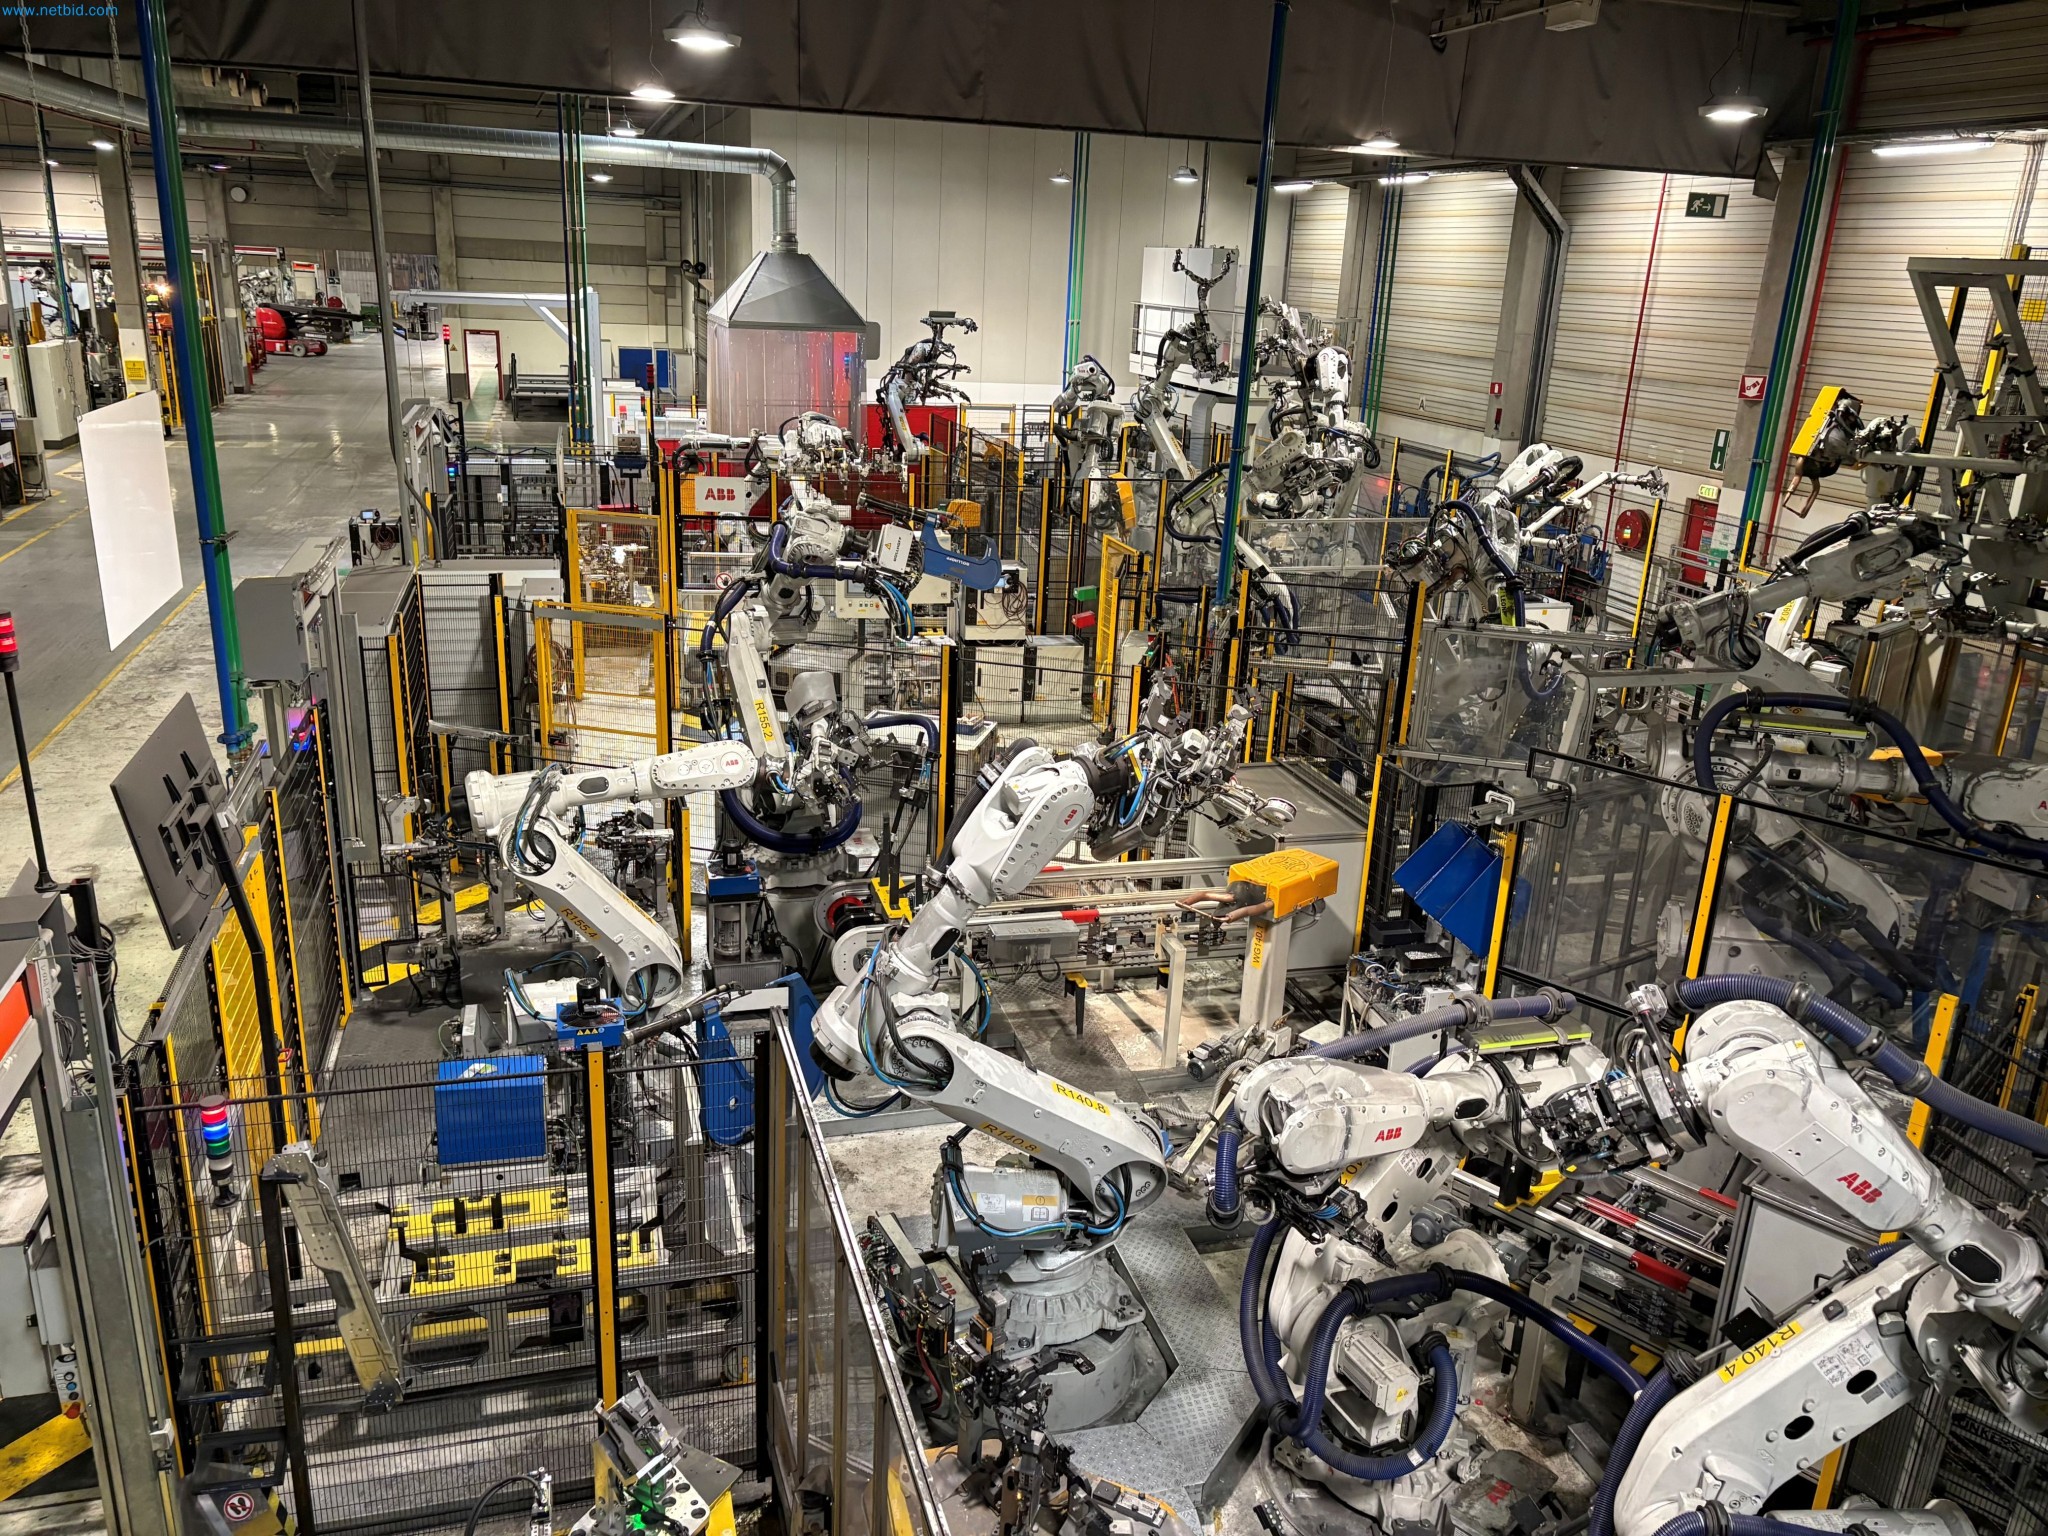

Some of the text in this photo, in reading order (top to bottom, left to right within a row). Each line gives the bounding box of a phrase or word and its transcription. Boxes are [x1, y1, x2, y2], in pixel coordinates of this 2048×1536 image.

[705, 487, 736, 502] ABB
[754, 701, 775, 739] R155.2
[725, 759, 740, 768] ABB
[1064, 809, 1077, 825] ABB
[560, 907, 598, 939] R155.4
[1251, 924, 1265, 964] WG140.1
[1055, 1083, 1107, 1115] R140.8
[982, 1122, 1038, 1152] R140.8
[1374, 1126, 1402, 1143] ABB
[1835, 1172, 1883, 1204] ABB
[1723, 1324, 1797, 1378] R140.4
